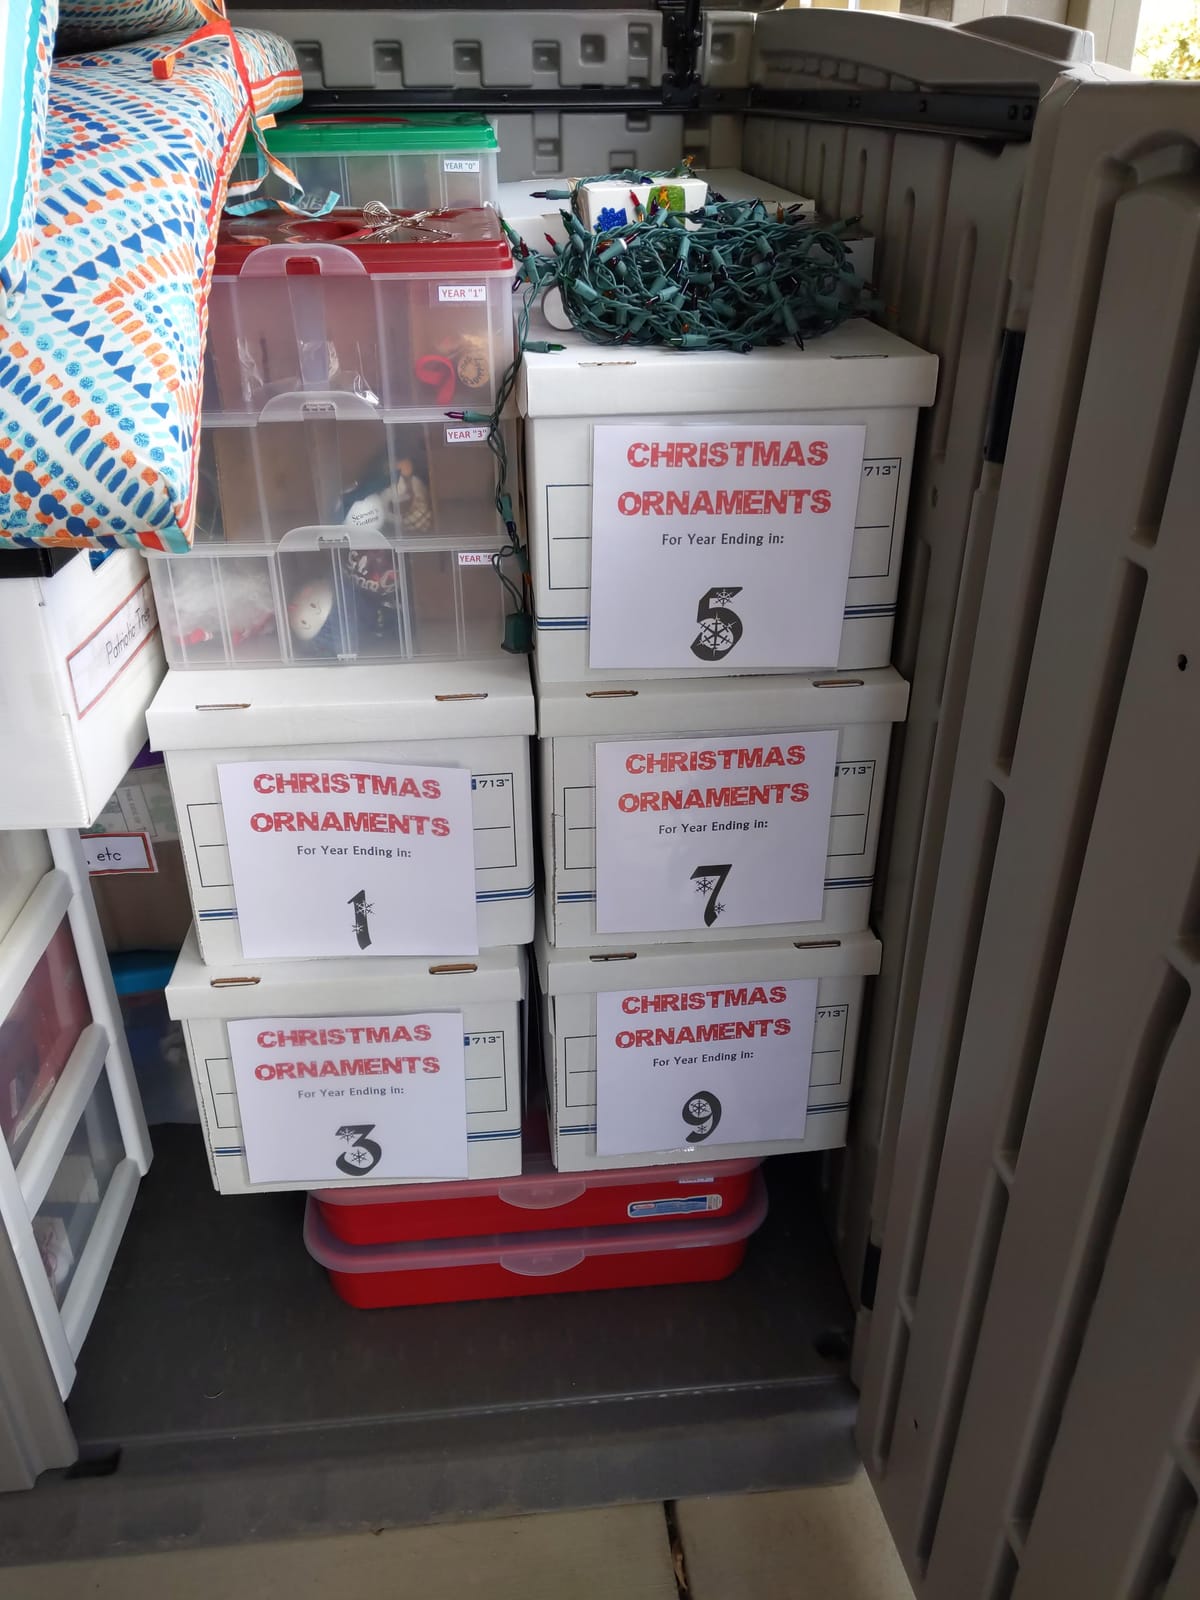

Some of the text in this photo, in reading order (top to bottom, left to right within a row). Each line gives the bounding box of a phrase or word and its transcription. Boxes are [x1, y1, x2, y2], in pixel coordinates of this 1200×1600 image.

[445, 162, 463, 170] YEAR
[441, 288, 483, 298] YEAR "1"
[447, 429, 487, 440] YEAR "3"
[626, 440, 829, 468] CHRISTMAS
[617, 489, 832, 516] ORNAMENTS
[662, 533, 785, 546] For Year Ending in:
[459, 554, 481, 563] YEAR
[689, 586, 743, 661] 5
[105, 622, 137, 664] Patriotic
[625, 745, 806, 775] CHRISTMAS
[253, 773, 441, 799] CHRISTMAS
[618, 783, 810, 813] ORNAMENTS
[250, 811, 450, 837] ORNAMENTS
[658, 819, 769, 835] For Year Ending in:
[96, 847, 122, 862] etc
[297, 845, 412, 858] For Year Ending in:
[690, 864, 733, 927] 7
[347, 889, 373, 950] 1
[621, 986, 787, 1015] CHRISTMAS
[256, 1024, 432, 1048] CHRISTMAS
[615, 1018, 792, 1049] ORNAMENTS
[254, 1056, 440, 1081] ORNAMENTS
[652, 1050, 754, 1067] For Year Ending in:
[297, 1086, 404, 1099] For Year Ending in:
[682, 1090, 722, 1143] 9
[335, 1124, 382, 1176] 3
